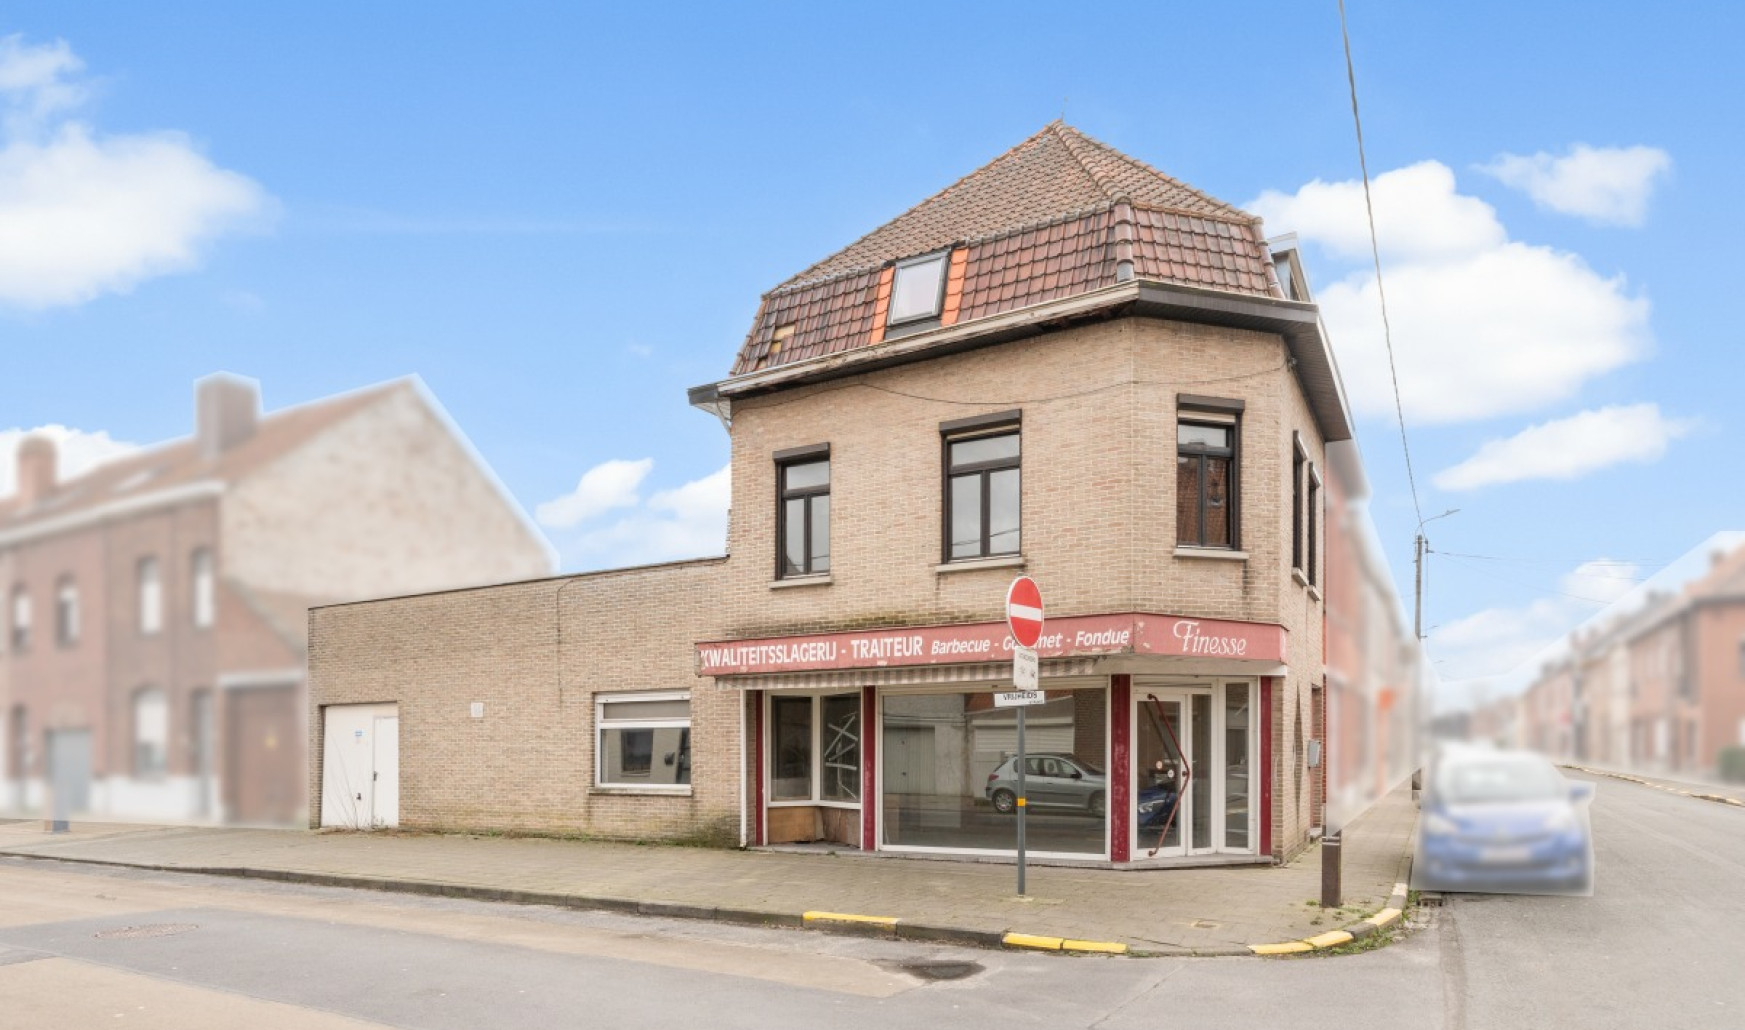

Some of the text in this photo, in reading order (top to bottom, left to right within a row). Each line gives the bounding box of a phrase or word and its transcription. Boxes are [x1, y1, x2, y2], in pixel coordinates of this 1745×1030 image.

[701, 641, 836, 668] KWALITEITSSLAGERIJ
[851, 636, 923, 659] TRAITEUR
[931, 639, 991, 655] Barbecue
[1002, 632, 1064, 651] Gmet
[1075, 629, 1130, 647] Fondue
[1173, 620, 1247, 655] Finesse
